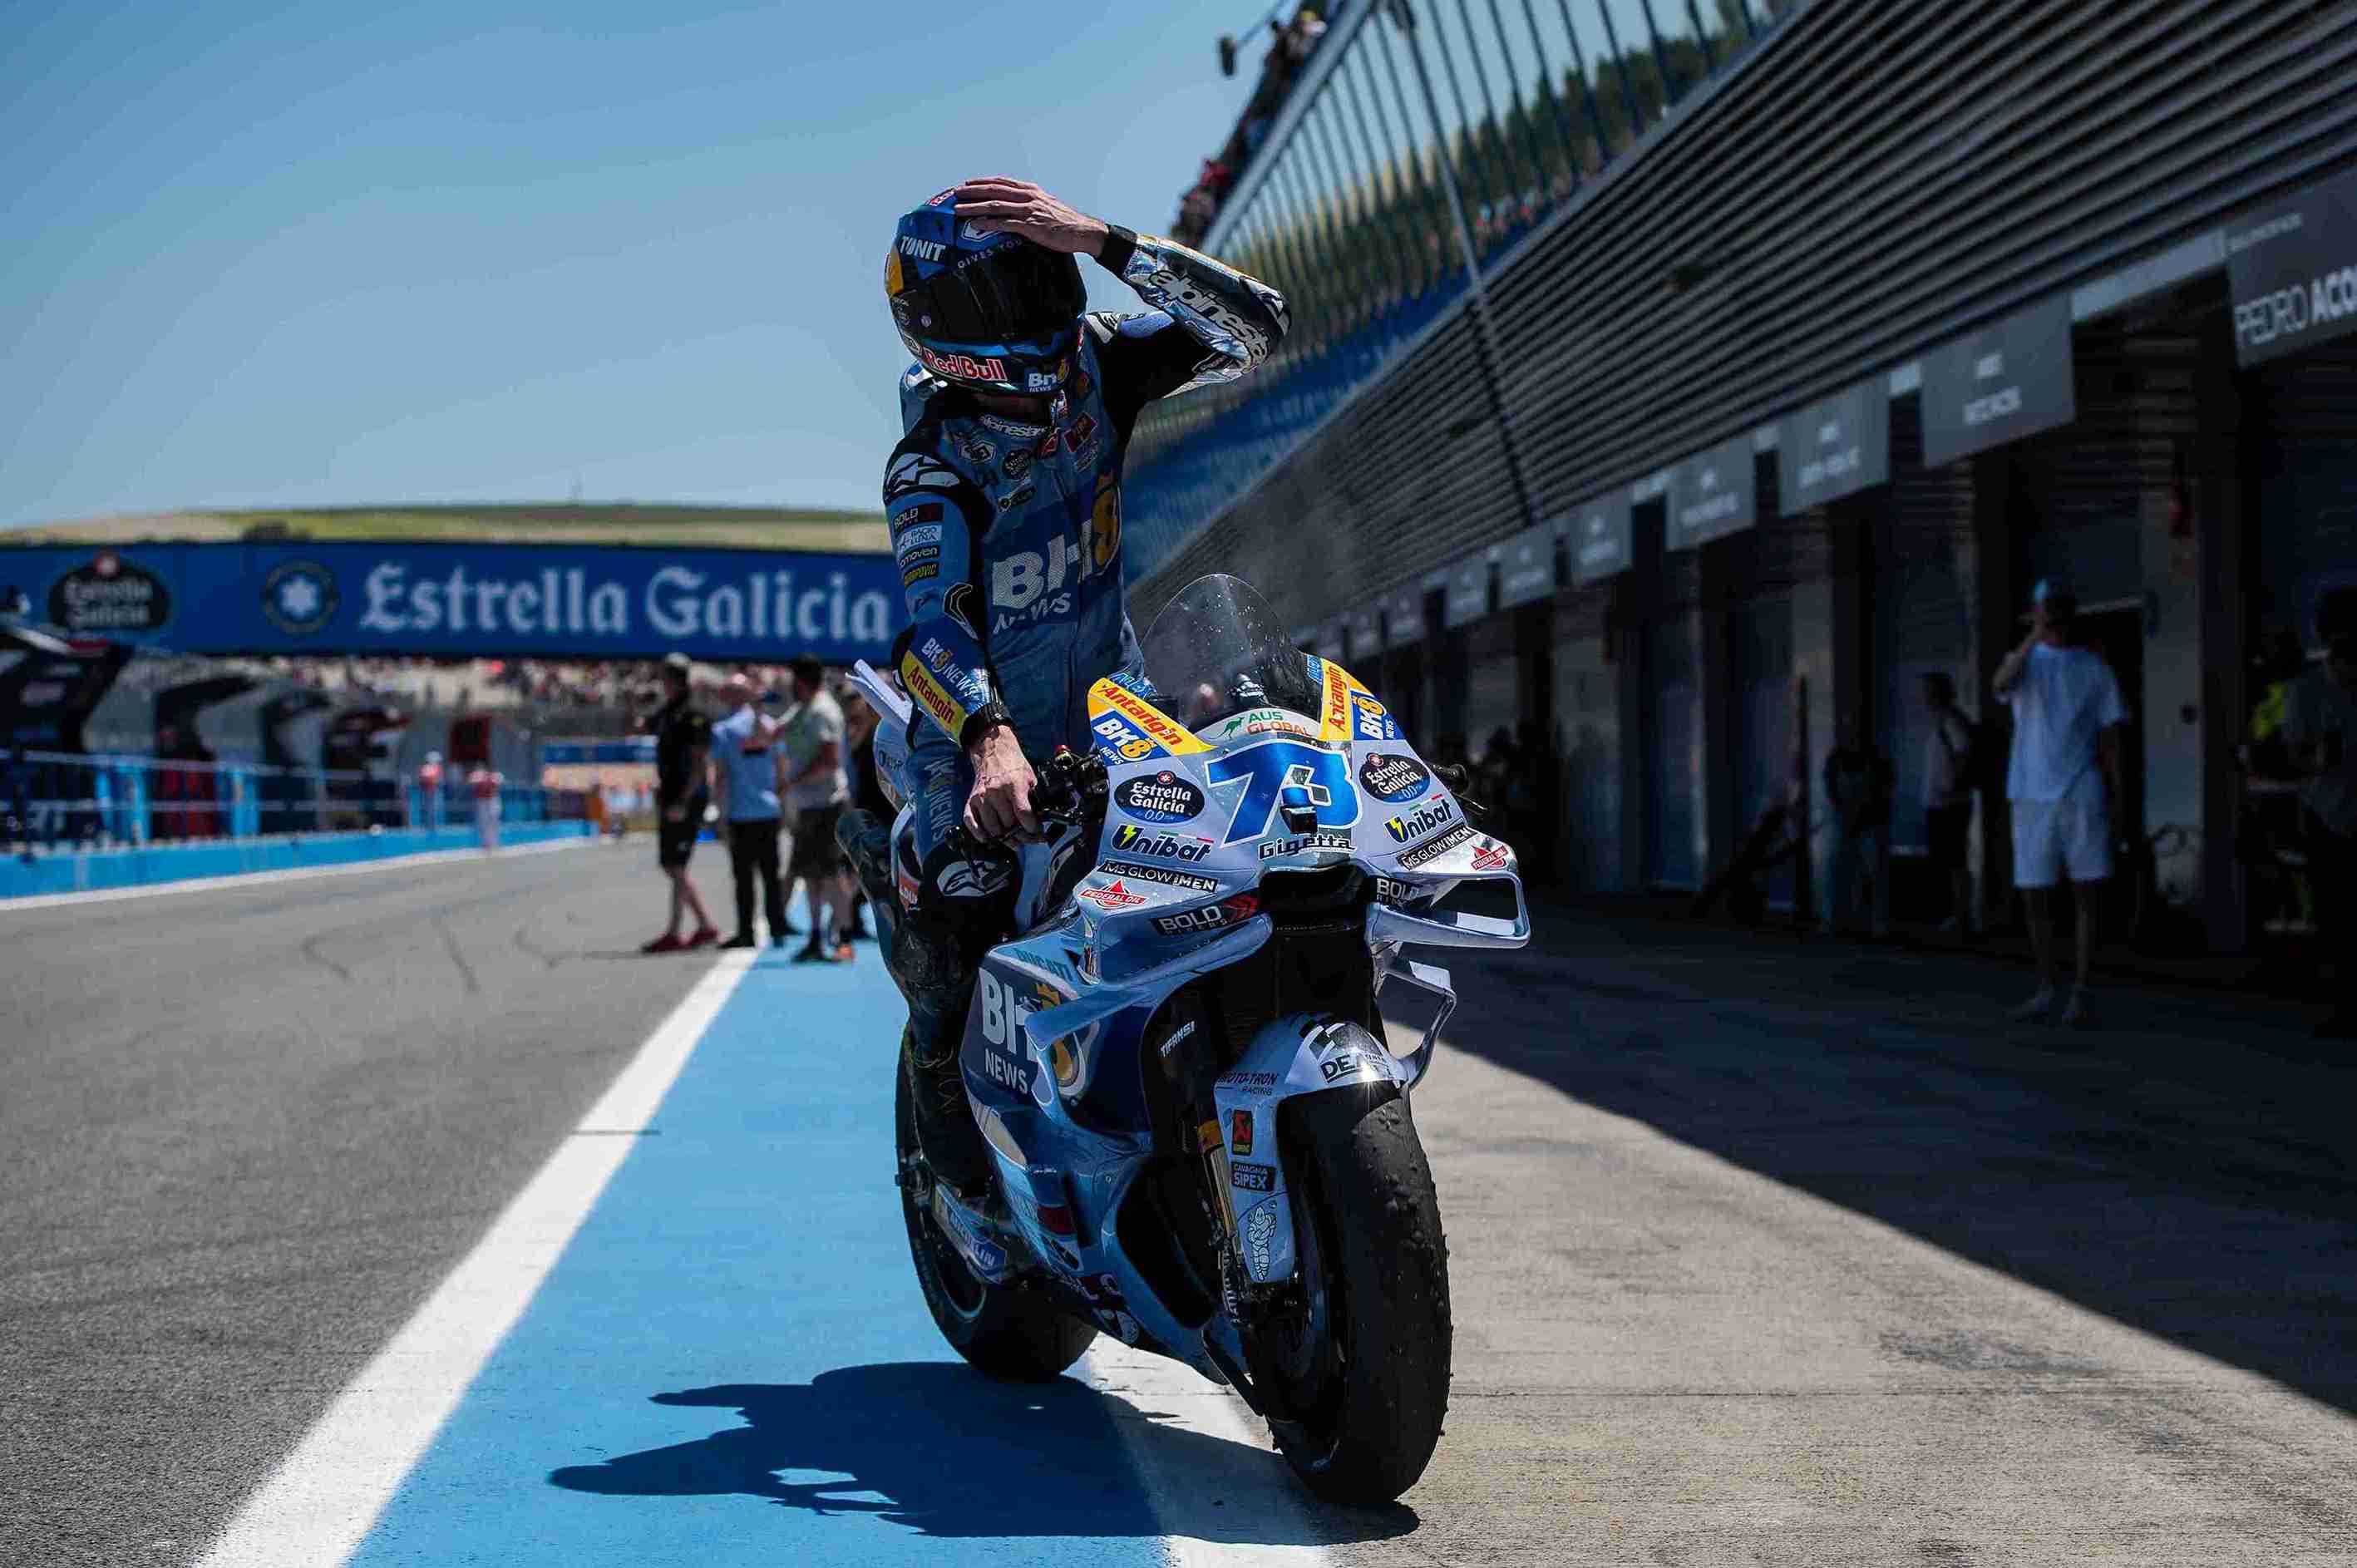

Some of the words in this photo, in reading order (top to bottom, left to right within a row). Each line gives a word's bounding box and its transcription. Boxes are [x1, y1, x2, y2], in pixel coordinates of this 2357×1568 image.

[2234, 286, 2309, 349] PEDRO
[924, 347, 961, 376] Red
[959, 356, 1008, 382] Bull
[359, 562, 629, 634] Estrella
[647, 565, 890, 642] Galicia
[993, 591, 1072, 634] NWS
[943, 663, 979, 698] NEWS
[906, 665, 955, 726] Antangin
[1097, 685, 1184, 746] Antangin
[1248, 711, 1284, 724] AUS
[1355, 697, 1386, 740] BK8
[1093, 717, 1154, 760] BK8
[1246, 722, 1313, 738] GLOBAL
[1100, 746, 1125, 765] NEWS
[1367, 760, 1411, 784] Estrella
[1378, 771, 1422, 794] Galicia
[1130, 794, 1185, 813] Galicia
[1131, 782, 1191, 801] Estrella
[1205, 738, 1362, 848] 73
[1385, 800, 1453, 844] Unibat
[1112, 824, 1211, 862] Unibat
[1258, 834, 1357, 860] Gigetta
[1402, 855, 1421, 870] MS
[1418, 840, 1449, 861] GLOW
[1105, 863, 1126, 874] MS
[1128, 865, 1172, 883] GLOW
[1473, 854, 1497, 870] FEDERAL
[1083, 890, 1126, 903] FEDERAL
[1126, 895, 1146, 905] OIL
[1377, 878, 1420, 900] BOLD
[1159, 905, 1222, 930] BOLD
[985, 1048, 1028, 1095] NEWS
[1233, 1171, 1268, 1191] SIPEX
